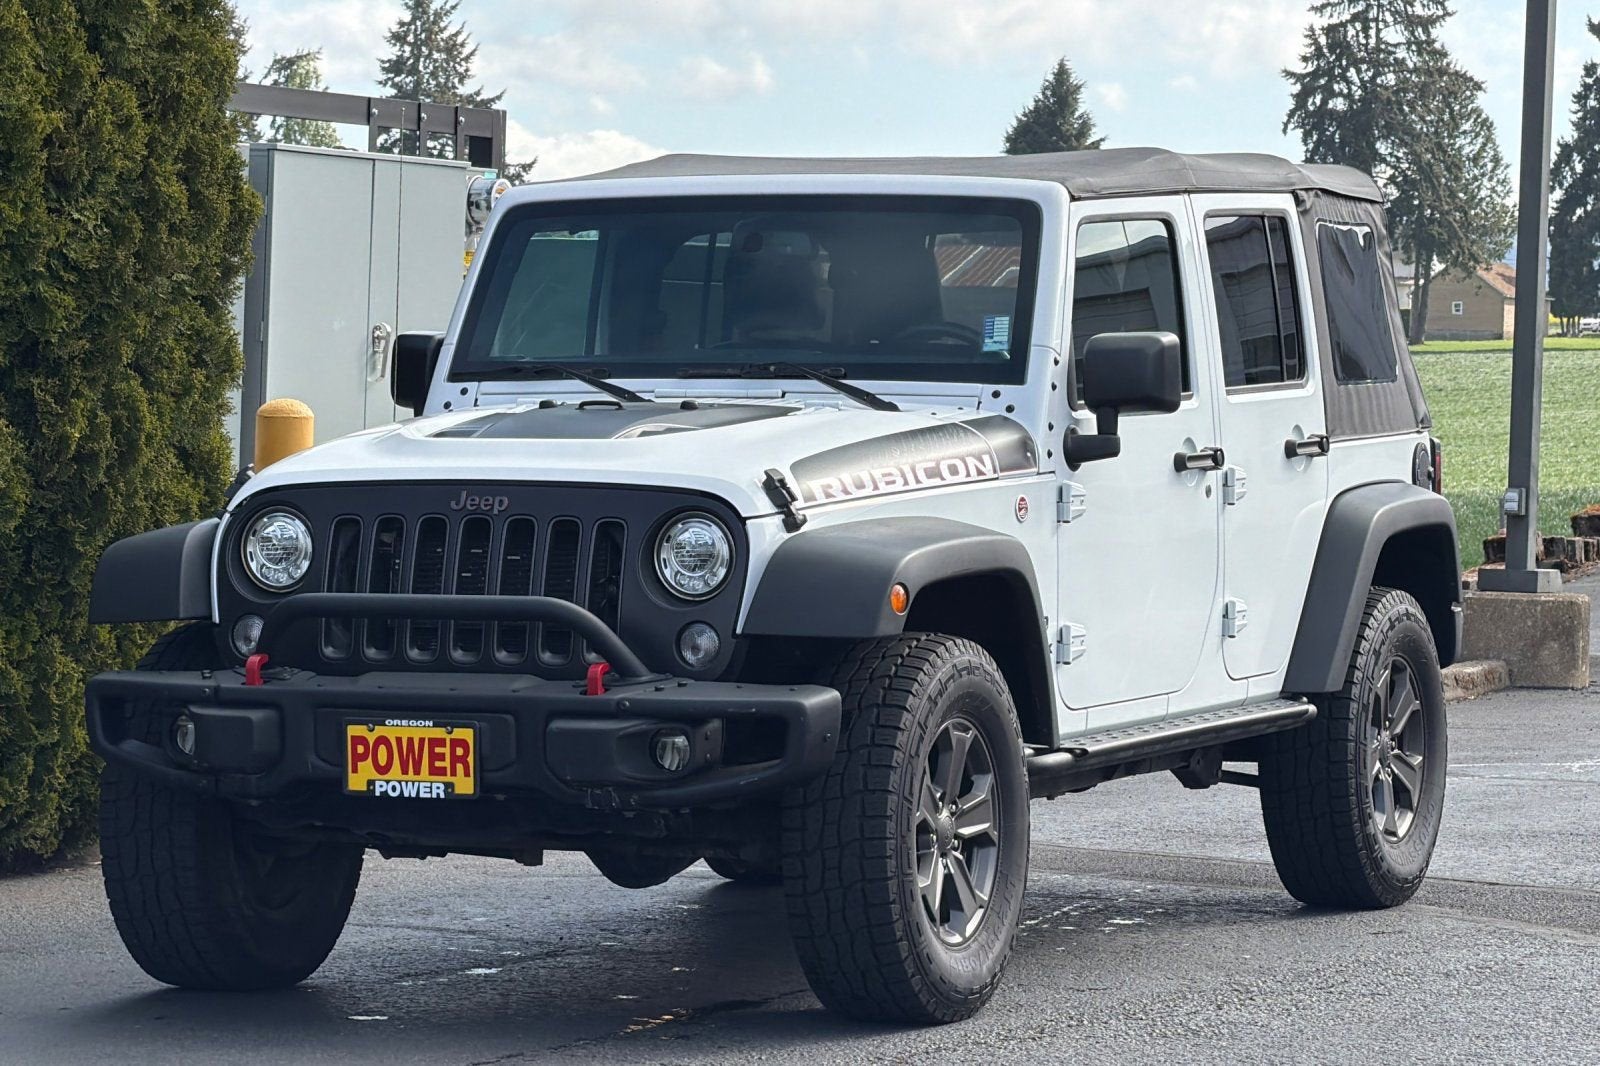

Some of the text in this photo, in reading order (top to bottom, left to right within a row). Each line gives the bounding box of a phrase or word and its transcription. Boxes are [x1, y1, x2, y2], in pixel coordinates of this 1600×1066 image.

[807, 454, 996, 501] RUBICON
[450, 490, 508, 514] Jeep
[385, 719, 433, 727] OREGON
[350, 735, 471, 777] POWER
[375, 780, 445, 799] POWER
